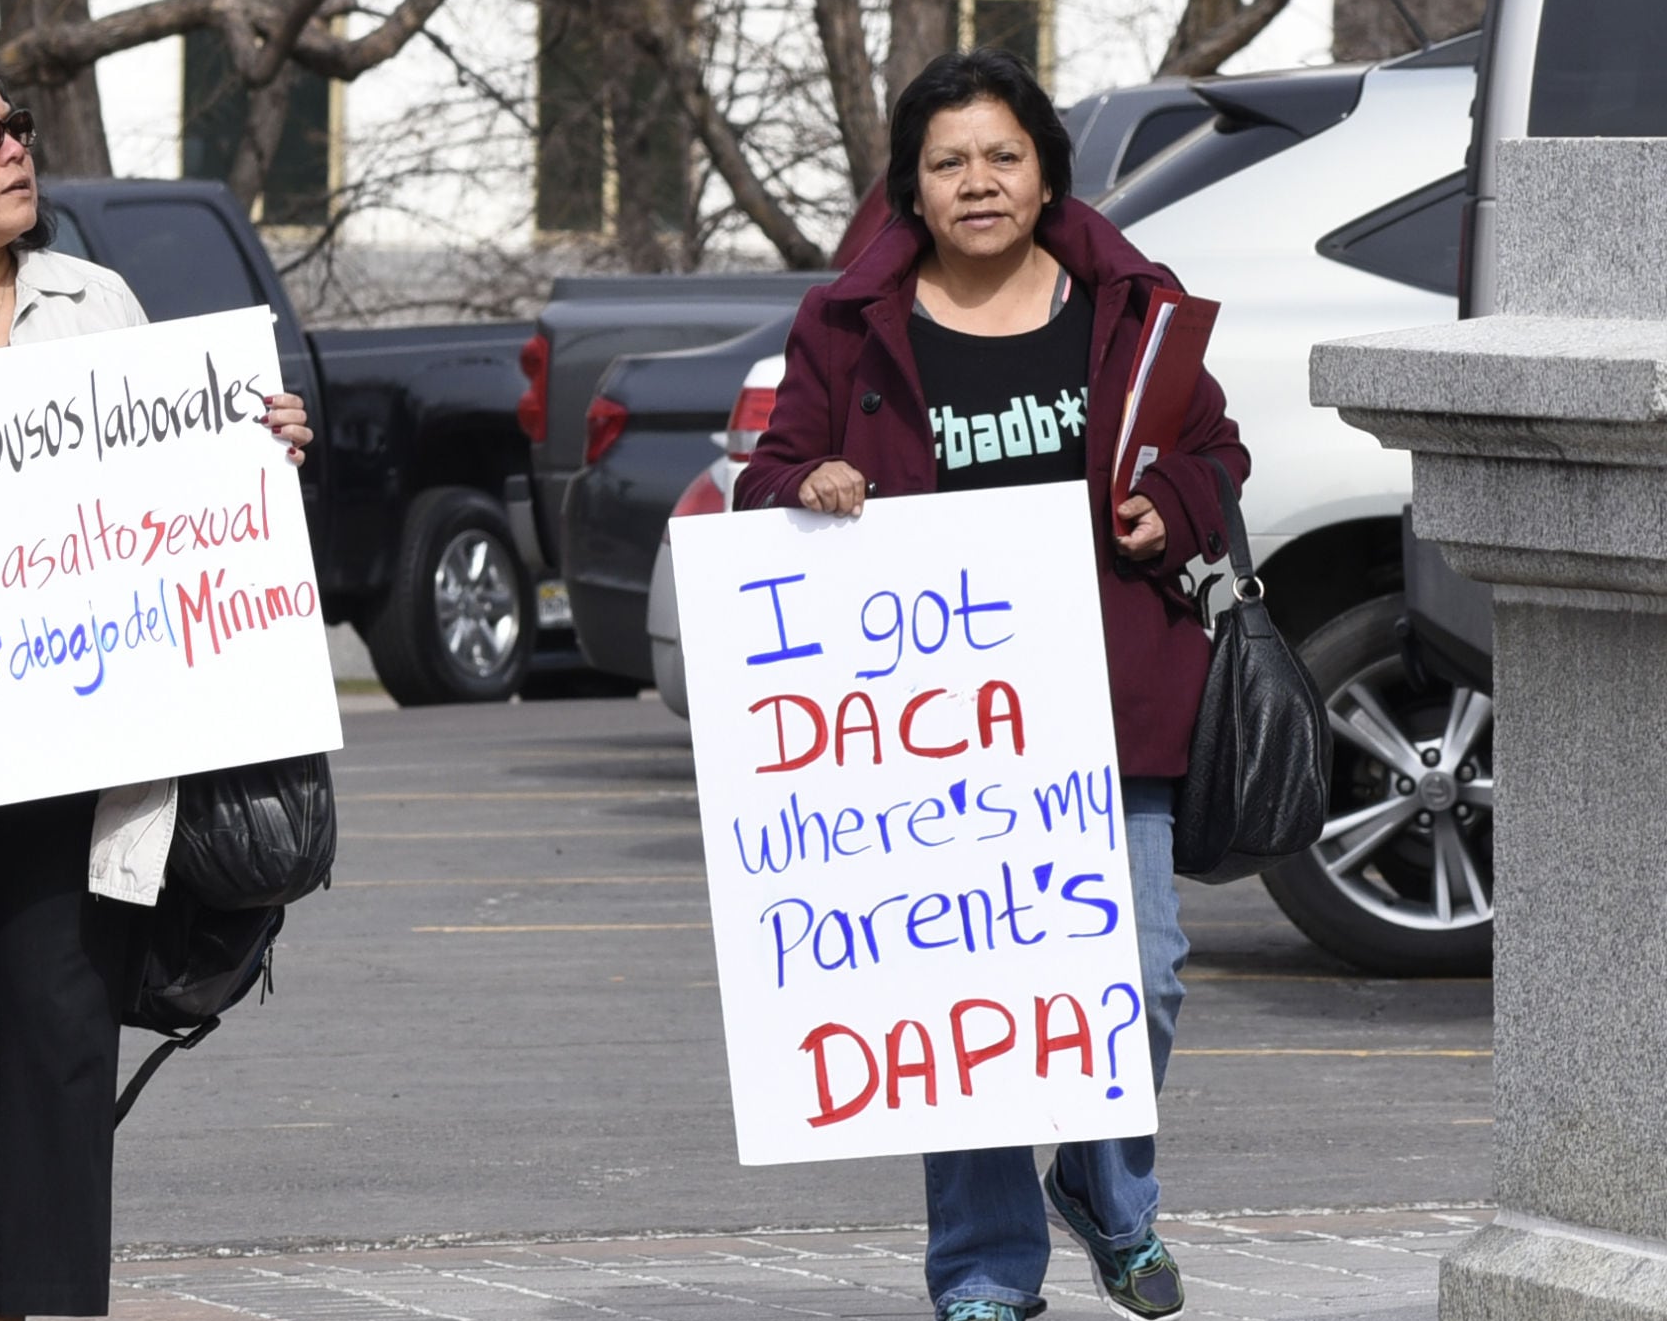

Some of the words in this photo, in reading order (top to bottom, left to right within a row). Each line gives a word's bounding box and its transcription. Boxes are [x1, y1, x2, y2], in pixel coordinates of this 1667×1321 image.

[91, 351, 271, 462] laborales
[2, 498, 137, 589] asalto
[141, 468, 270, 565] sexual
[10, 600, 120, 696] debajo
[125, 578, 177, 649] del
[176, 568, 316, 668] Mínimo
[739, 573, 823, 666] I
[855, 568, 1015, 681] got
[747, 680, 1026, 774] DACA
[1034, 765, 1116, 850] my
[760, 862, 1120, 988] Parent's
[798, 983, 1141, 1129] DAPA?
